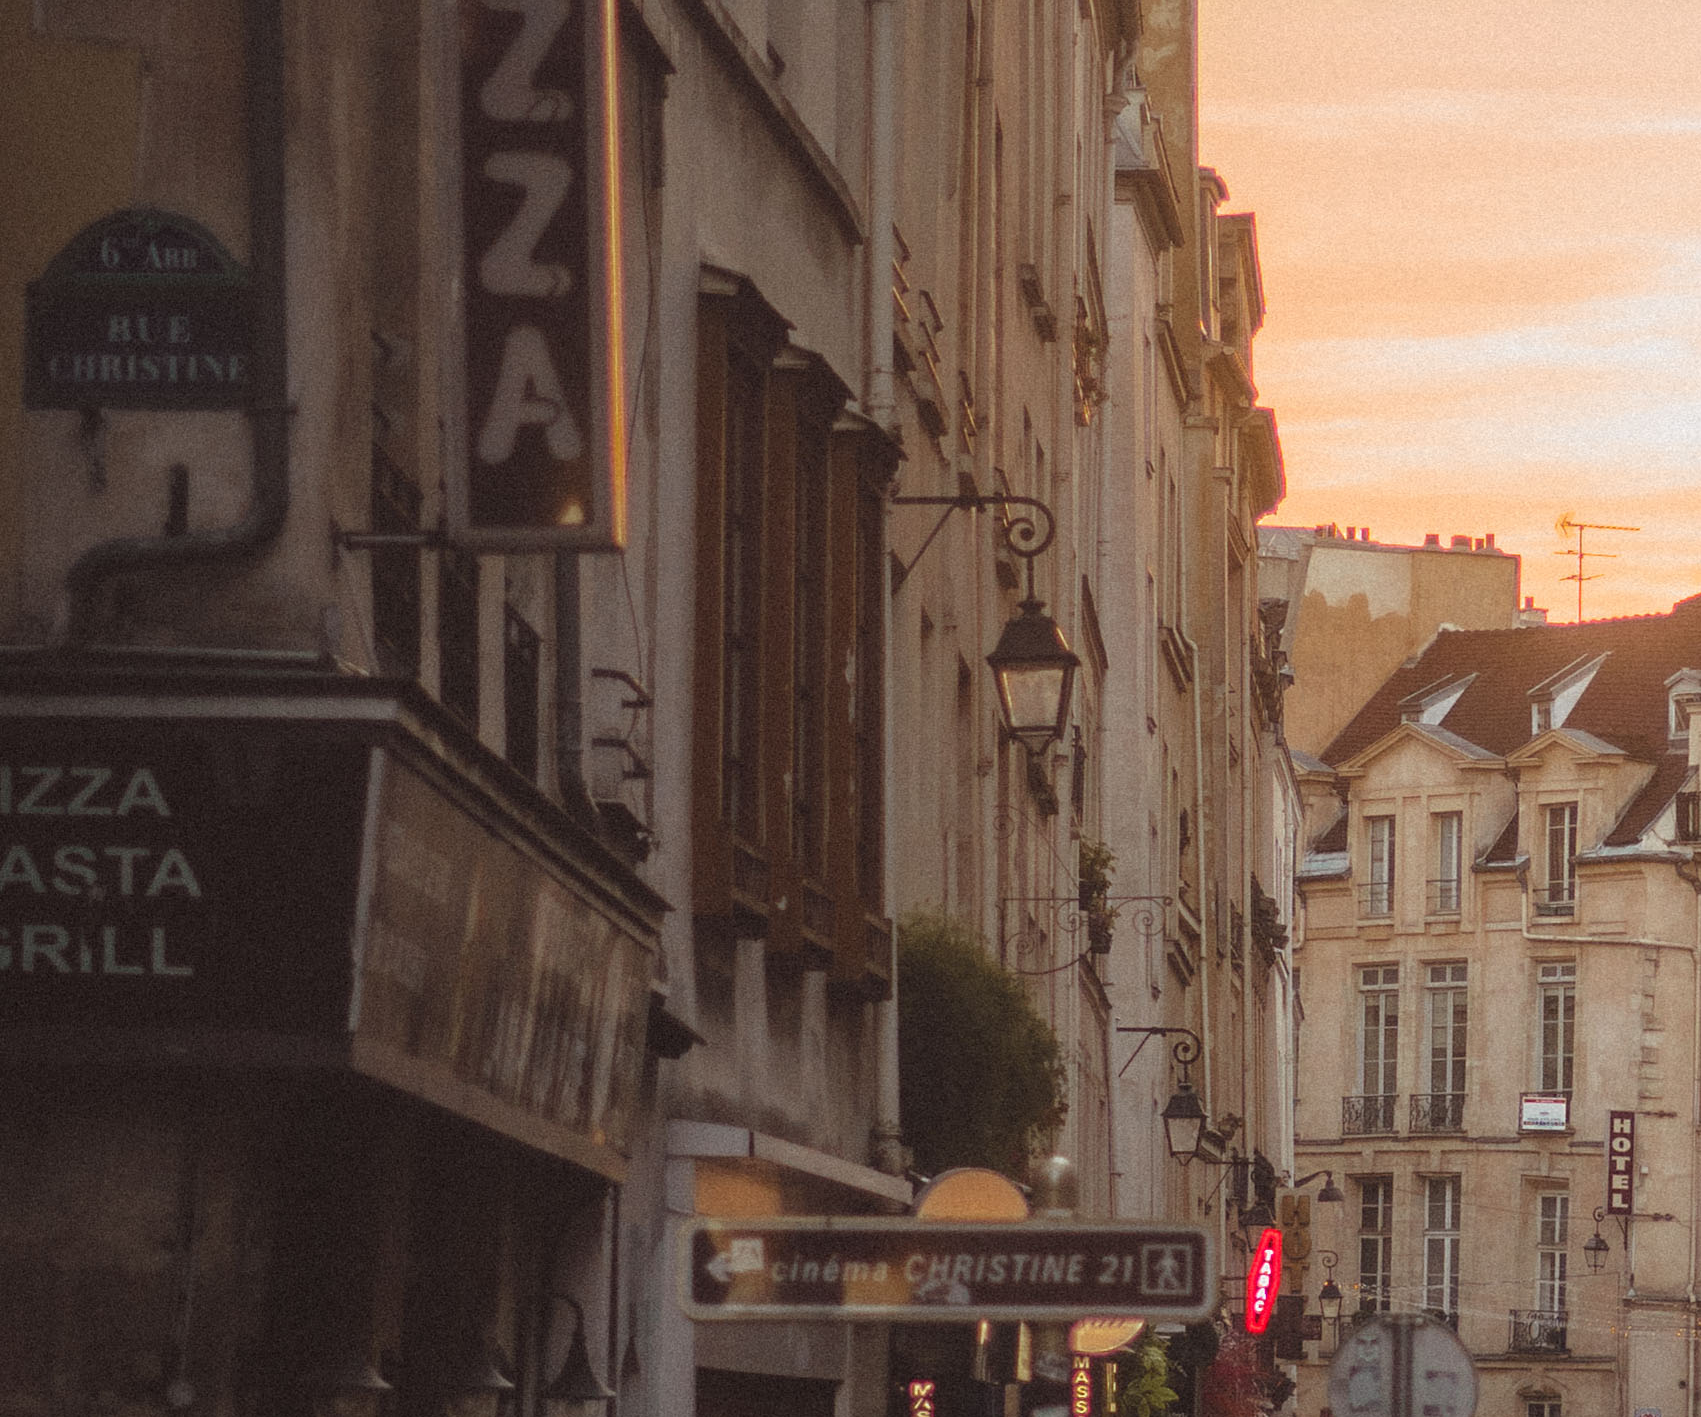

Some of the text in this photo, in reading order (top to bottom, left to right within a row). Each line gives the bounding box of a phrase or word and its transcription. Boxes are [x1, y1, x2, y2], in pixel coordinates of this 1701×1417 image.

[109, 315, 190, 343] RUE
[48, 354, 248, 382] CHRISTINE
[0, 924, 193, 975] RILL
[1611, 1117, 1632, 1210] HOTEL
[904, 1253, 1084, 1284] CHRISTINE
[1099, 1254, 1135, 1283] 21
[1254, 1249, 1274, 1312] TABAC
